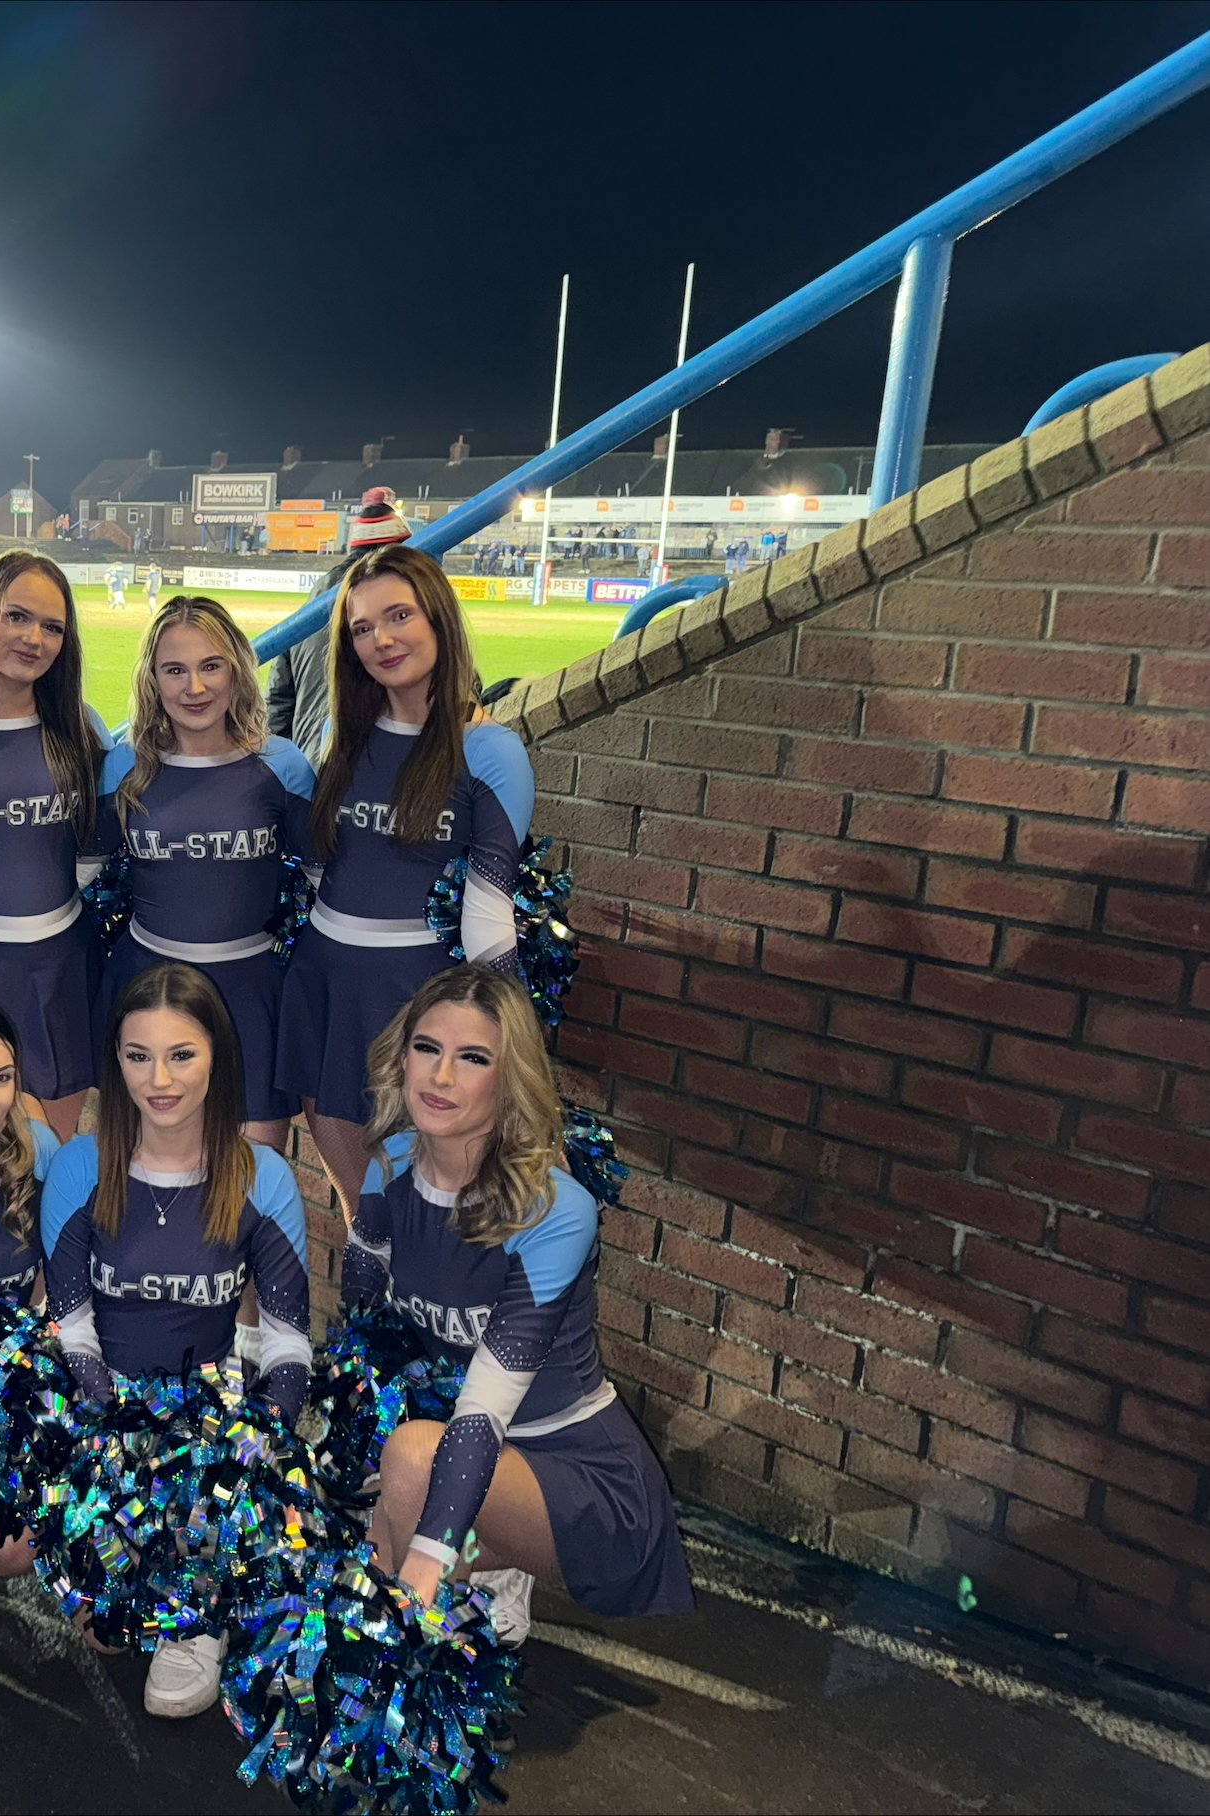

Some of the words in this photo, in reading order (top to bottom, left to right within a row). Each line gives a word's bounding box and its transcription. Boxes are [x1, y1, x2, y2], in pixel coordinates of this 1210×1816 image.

[204, 484, 263, 497] BOWKIRK
[451, 579, 487, 589] ROSSLEY
[506, 579, 522, 589] RG
[527, 580, 586, 591] CRPETS
[595, 584, 648, 600] BETFR
[124, 825, 277, 860] LL-STARS
